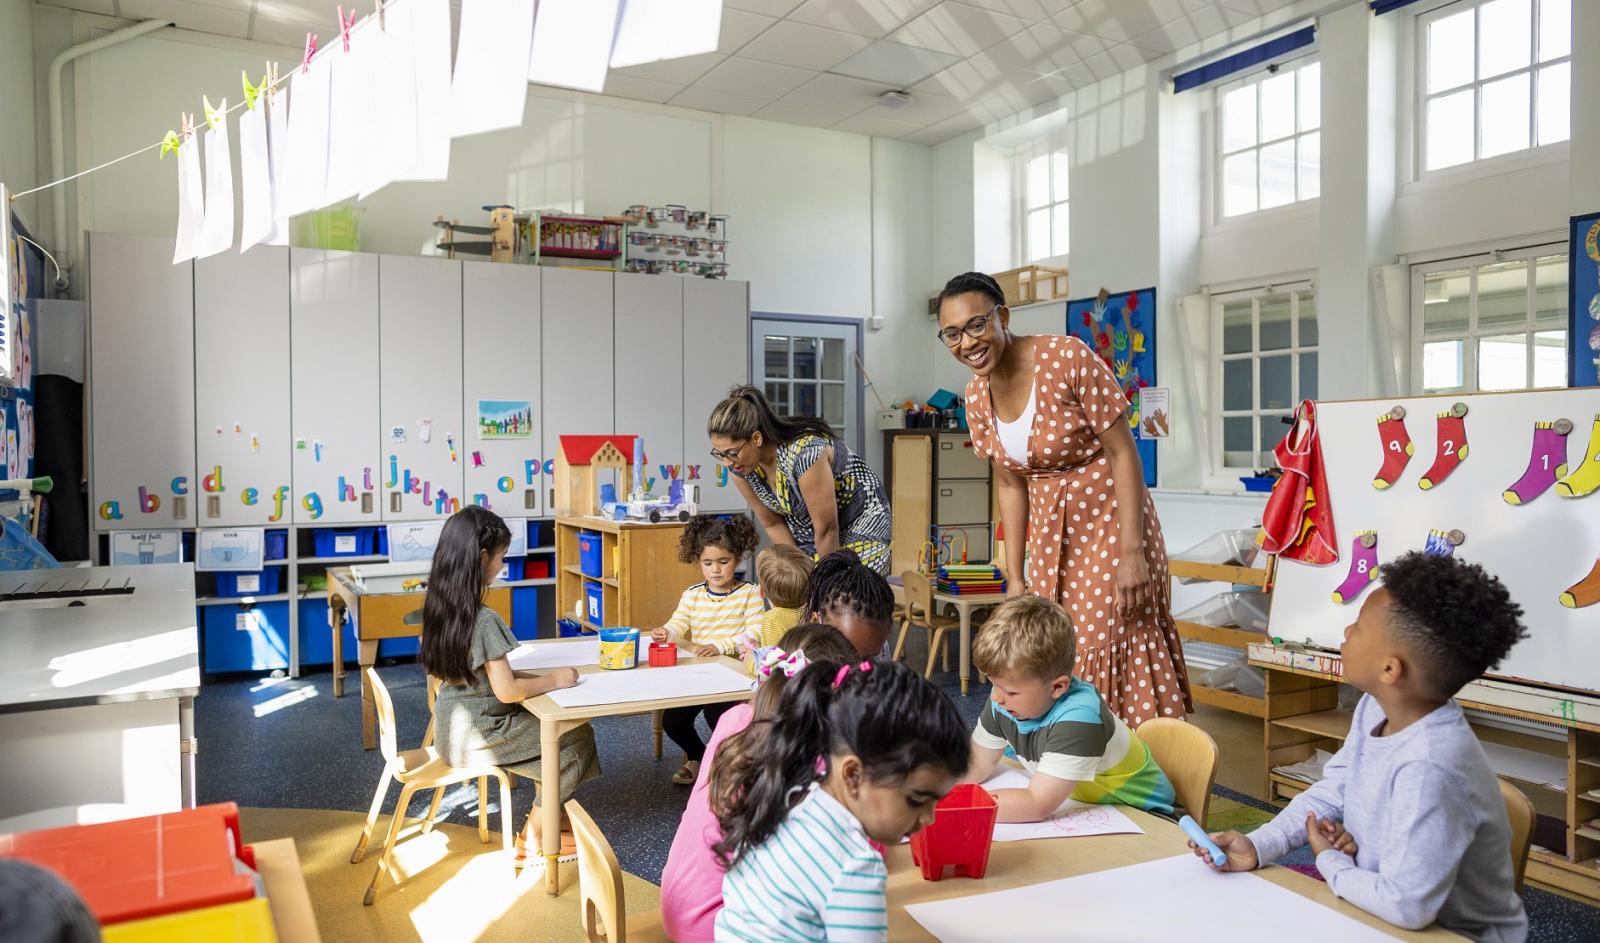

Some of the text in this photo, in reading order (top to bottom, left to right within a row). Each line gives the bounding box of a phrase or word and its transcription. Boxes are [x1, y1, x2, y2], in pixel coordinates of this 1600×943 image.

[1389, 440, 1402, 454] 9
[1442, 440, 1455, 456] 2
[1540, 454, 1549, 470] 1
[100, 500, 123, 520] a
[138, 486, 160, 513] b
[171, 476, 188, 495] c
[202, 465, 226, 492] d
[241, 487, 258, 506] e
[268, 485, 290, 522] f
[302, 492, 324, 520] g
[338, 476, 358, 502] h
[363, 467, 374, 490] i
[385, 455, 399, 488] j
[403, 469, 422, 494] k
[423, 481, 432, 506] l
[435, 497, 460, 514] m
[473, 494, 492, 510] n
[497, 476, 514, 493] o
[524, 459, 541, 485] p
[659, 464, 682, 480] w
[687, 464, 701, 480] x
[715, 463, 728, 487] y
[1357, 559, 1368, 574] 8
